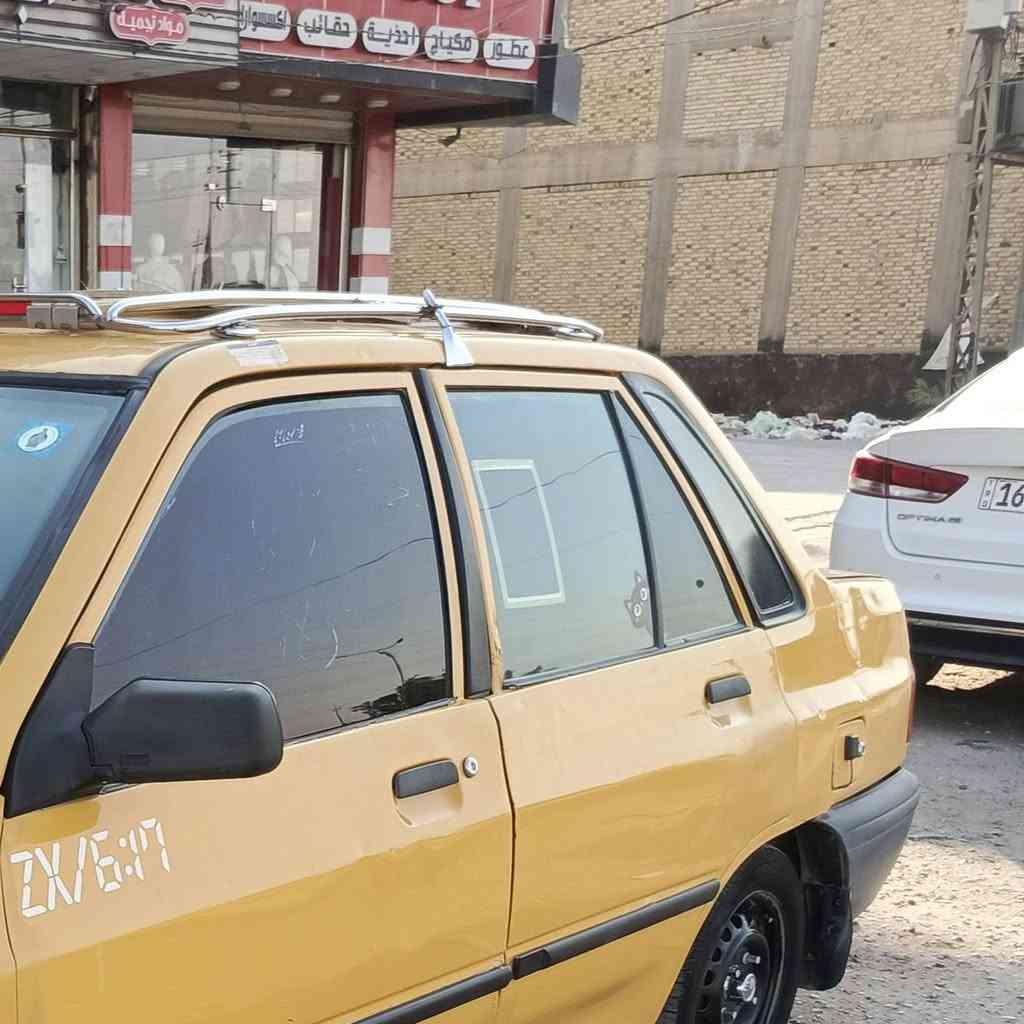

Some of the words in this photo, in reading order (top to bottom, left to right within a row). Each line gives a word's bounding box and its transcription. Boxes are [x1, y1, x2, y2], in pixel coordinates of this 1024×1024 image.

[304, 14, 350, 38] حقائب
[367, 21, 416, 48] احذية
[430, 31, 472, 55] مكياج
[491, 39, 529, 61] عطور
